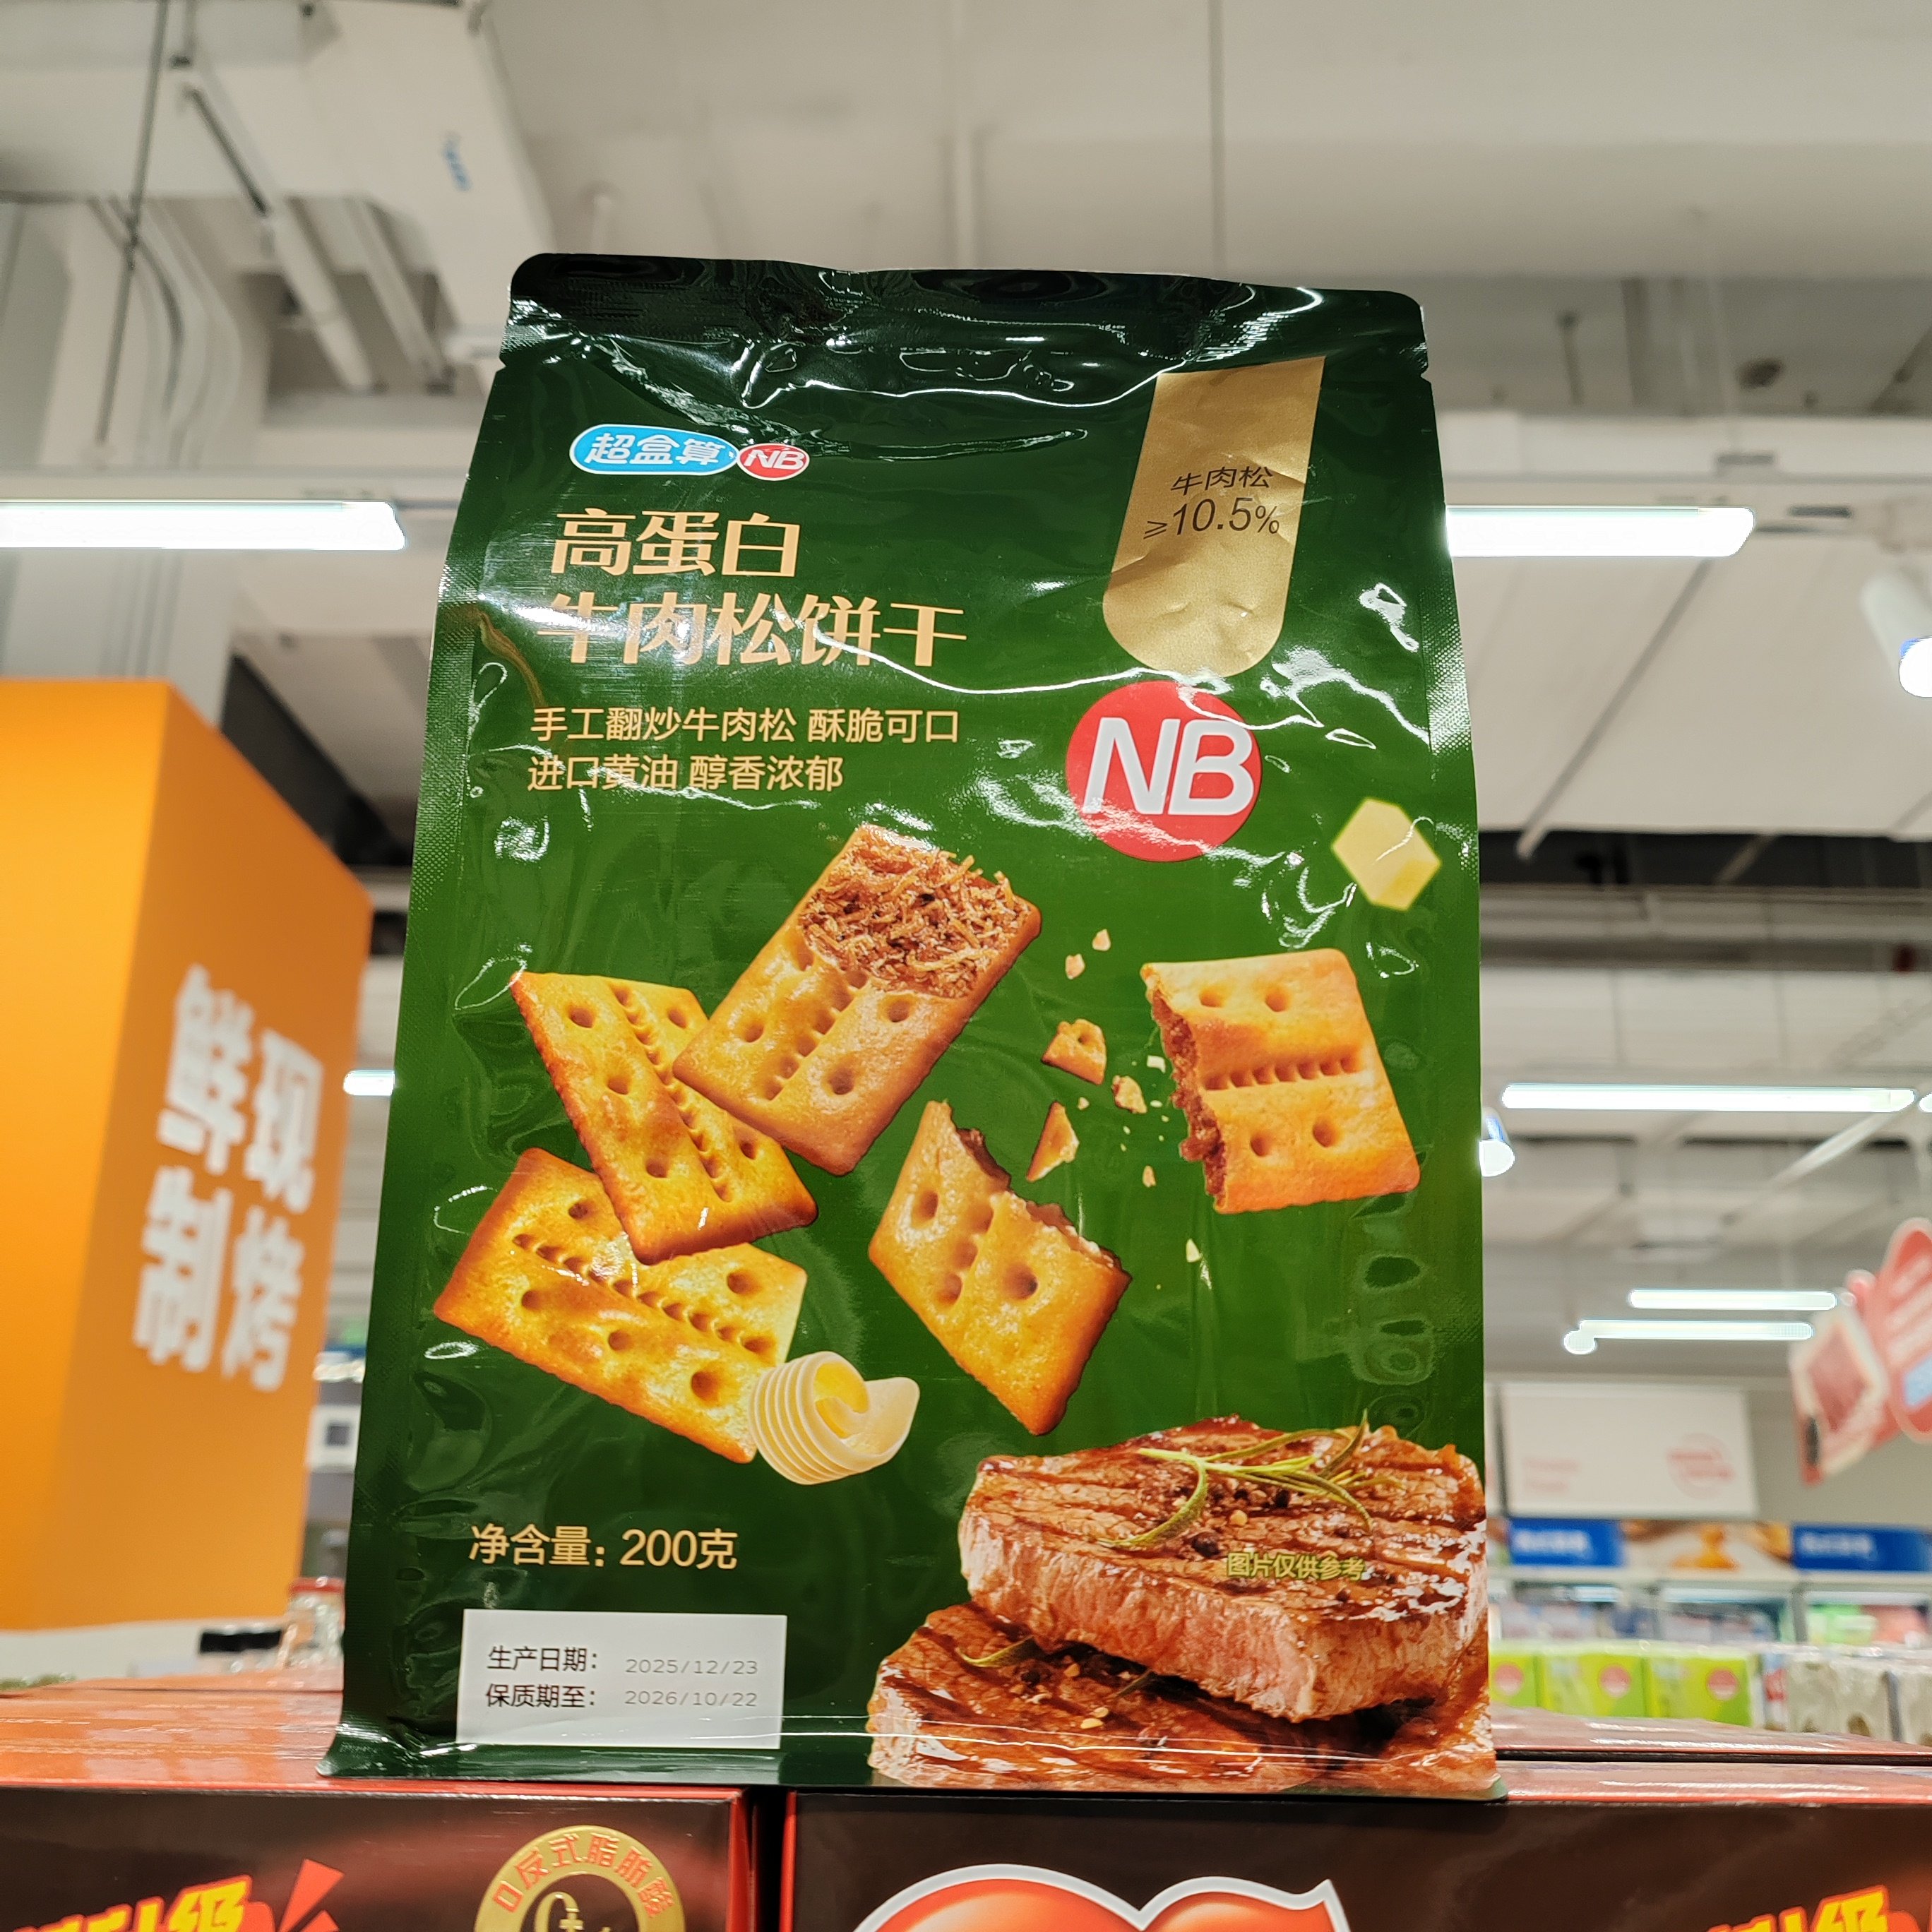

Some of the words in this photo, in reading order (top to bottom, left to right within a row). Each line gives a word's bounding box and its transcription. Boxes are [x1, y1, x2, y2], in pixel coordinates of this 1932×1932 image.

[584, 433, 726, 465] 超盒算
[744, 448, 806, 470] NB
[1171, 466, 1273, 496] 牛肉松
[551, 508, 800, 577] 高蛋白
[537, 591, 967, 667] 牛肉松饼干
[530, 707, 797, 743] 手工翻炒牛肉松
[808, 709, 959, 744] 酥脆可口
[527, 755, 678, 791] 进口黄油
[689, 755, 843, 792] 醇香浓郁
[1083, 717, 1254, 816] NB
[1227, 1553, 1366, 1581] 图片仅供参考
[625, 1659, 758, 1676] 2025/12/23
[624, 1690, 758, 1707] 2026/10/22
